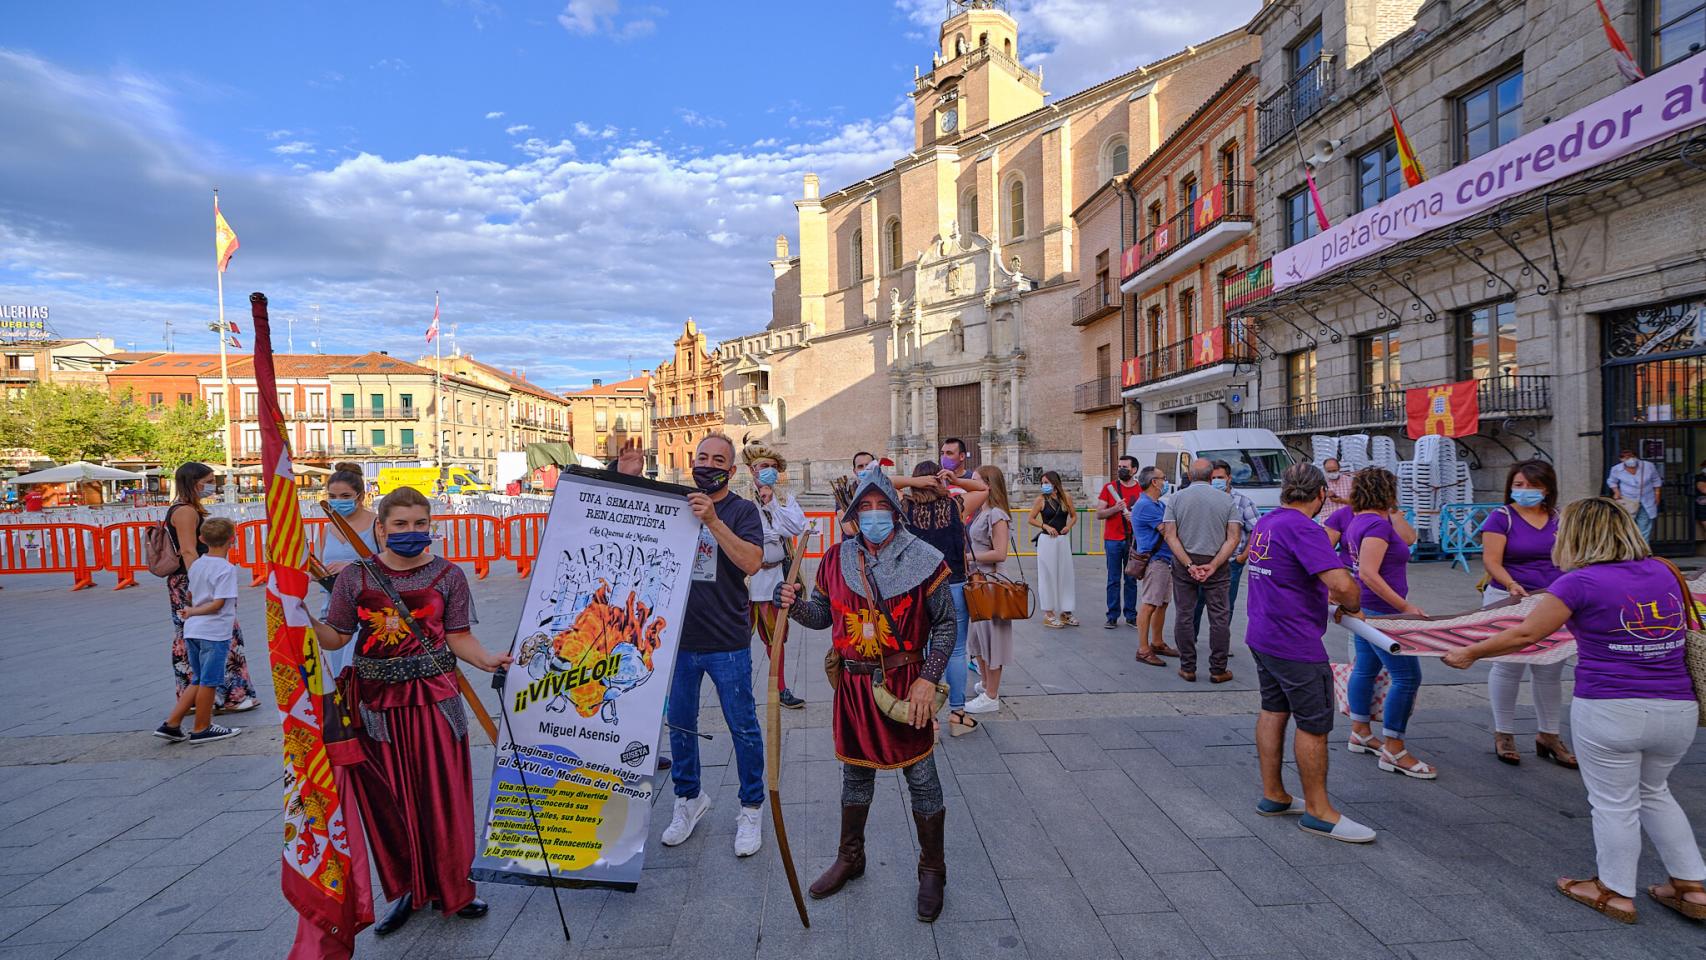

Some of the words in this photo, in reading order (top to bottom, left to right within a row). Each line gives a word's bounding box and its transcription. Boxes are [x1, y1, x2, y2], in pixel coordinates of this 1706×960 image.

[1320, 190, 1443, 267] plataforma
[1456, 103, 1643, 205] corredor
[579, 492, 602, 504] UNA
[606, 496, 650, 512] SEMANA
[655, 504, 680, 516] MUY
[585, 508, 666, 530] RENACENTISTA
[625, 531, 633, 539] de
[538, 721, 576, 738] Miguel
[578, 726, 620, 743] Asensio
[501, 742, 554, 760] ¿Imaginas
[555, 754, 583, 766] como
[585, 761, 610, 773] sería
[612, 767, 640, 781] viajar
[499, 757, 510, 766] al
[541, 766, 554, 776] de
[556, 769, 592, 785] Medina
[594, 779, 610, 789] del
[612, 783, 651, 800] Campo?
[499, 782, 513, 790] Una
[515, 785, 540, 793] novela
[542, 788, 557, 796] muy
[559, 790, 575, 798] muy
[576, 791, 608, 800] divertida
[496, 795, 510, 803] por
[511, 795, 518, 803] la
[535, 799, 574, 808] conocerás
[492, 820, 545, 831] emblemáticos
[494, 808, 526, 816] edificios
[575, 814, 596, 823] bares
[596, 817, 603, 825] y
[490, 832, 500, 841] Su
[501, 833, 520, 842] bella
[522, 835, 552, 845] Semana
[553, 838, 602, 849] Renacentista
[484, 847, 492, 856] y
[492, 846, 501, 854] la
[501, 848, 523, 857] gente
[524, 850, 539, 859] que
